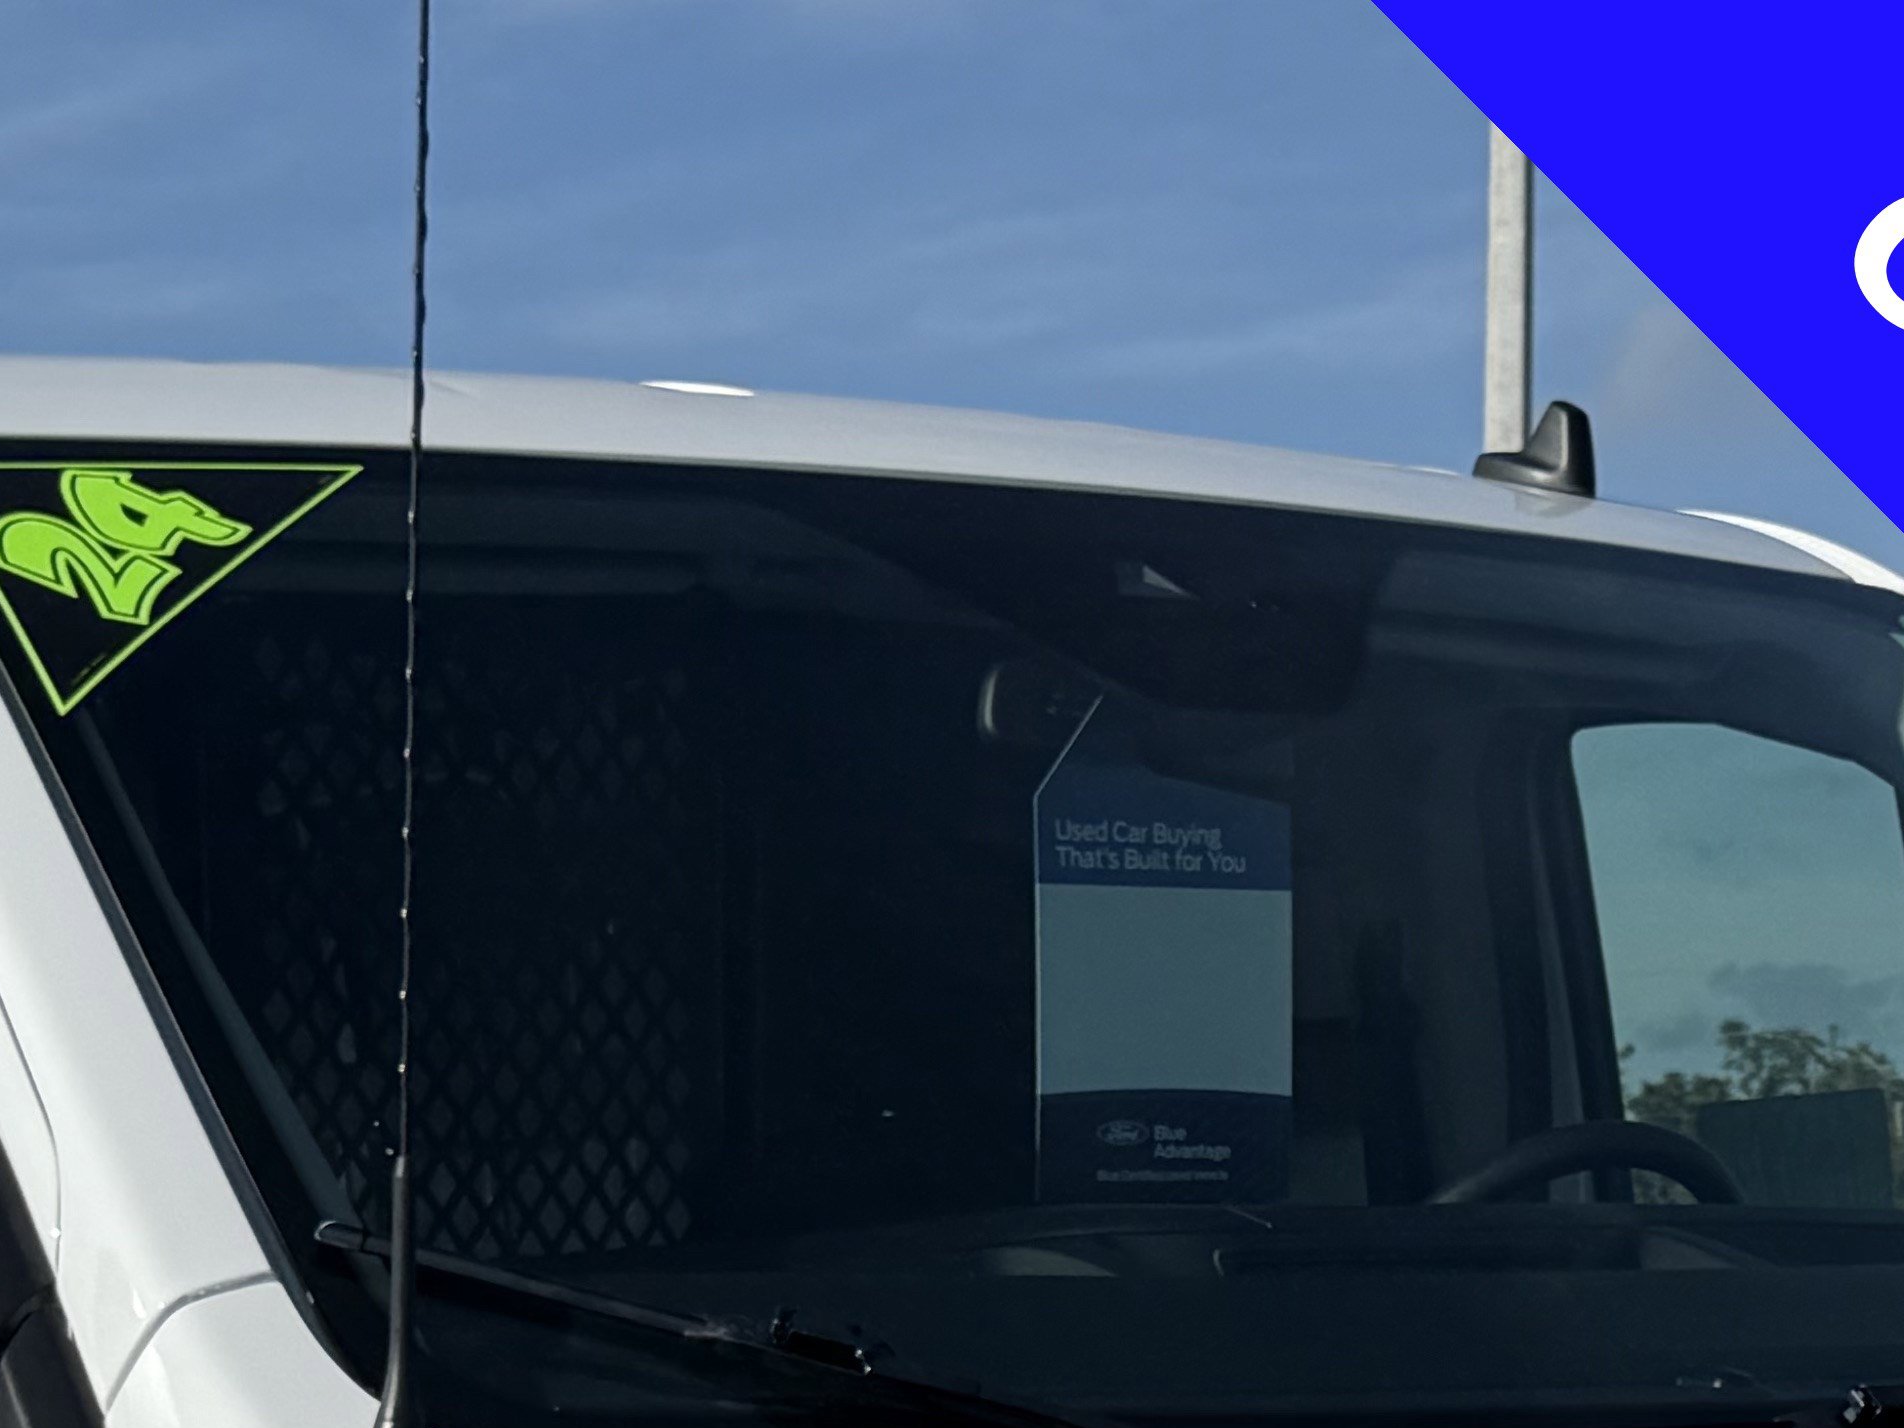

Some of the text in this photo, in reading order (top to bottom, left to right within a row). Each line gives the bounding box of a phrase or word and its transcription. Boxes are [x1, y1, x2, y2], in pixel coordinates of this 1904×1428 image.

[1055, 819, 1222, 850] Used Car Buying
[1055, 845, 1247, 873] That's Built for You
[1153, 1124, 1187, 1141] Blue
[1153, 1143, 1232, 1162] Advantage
